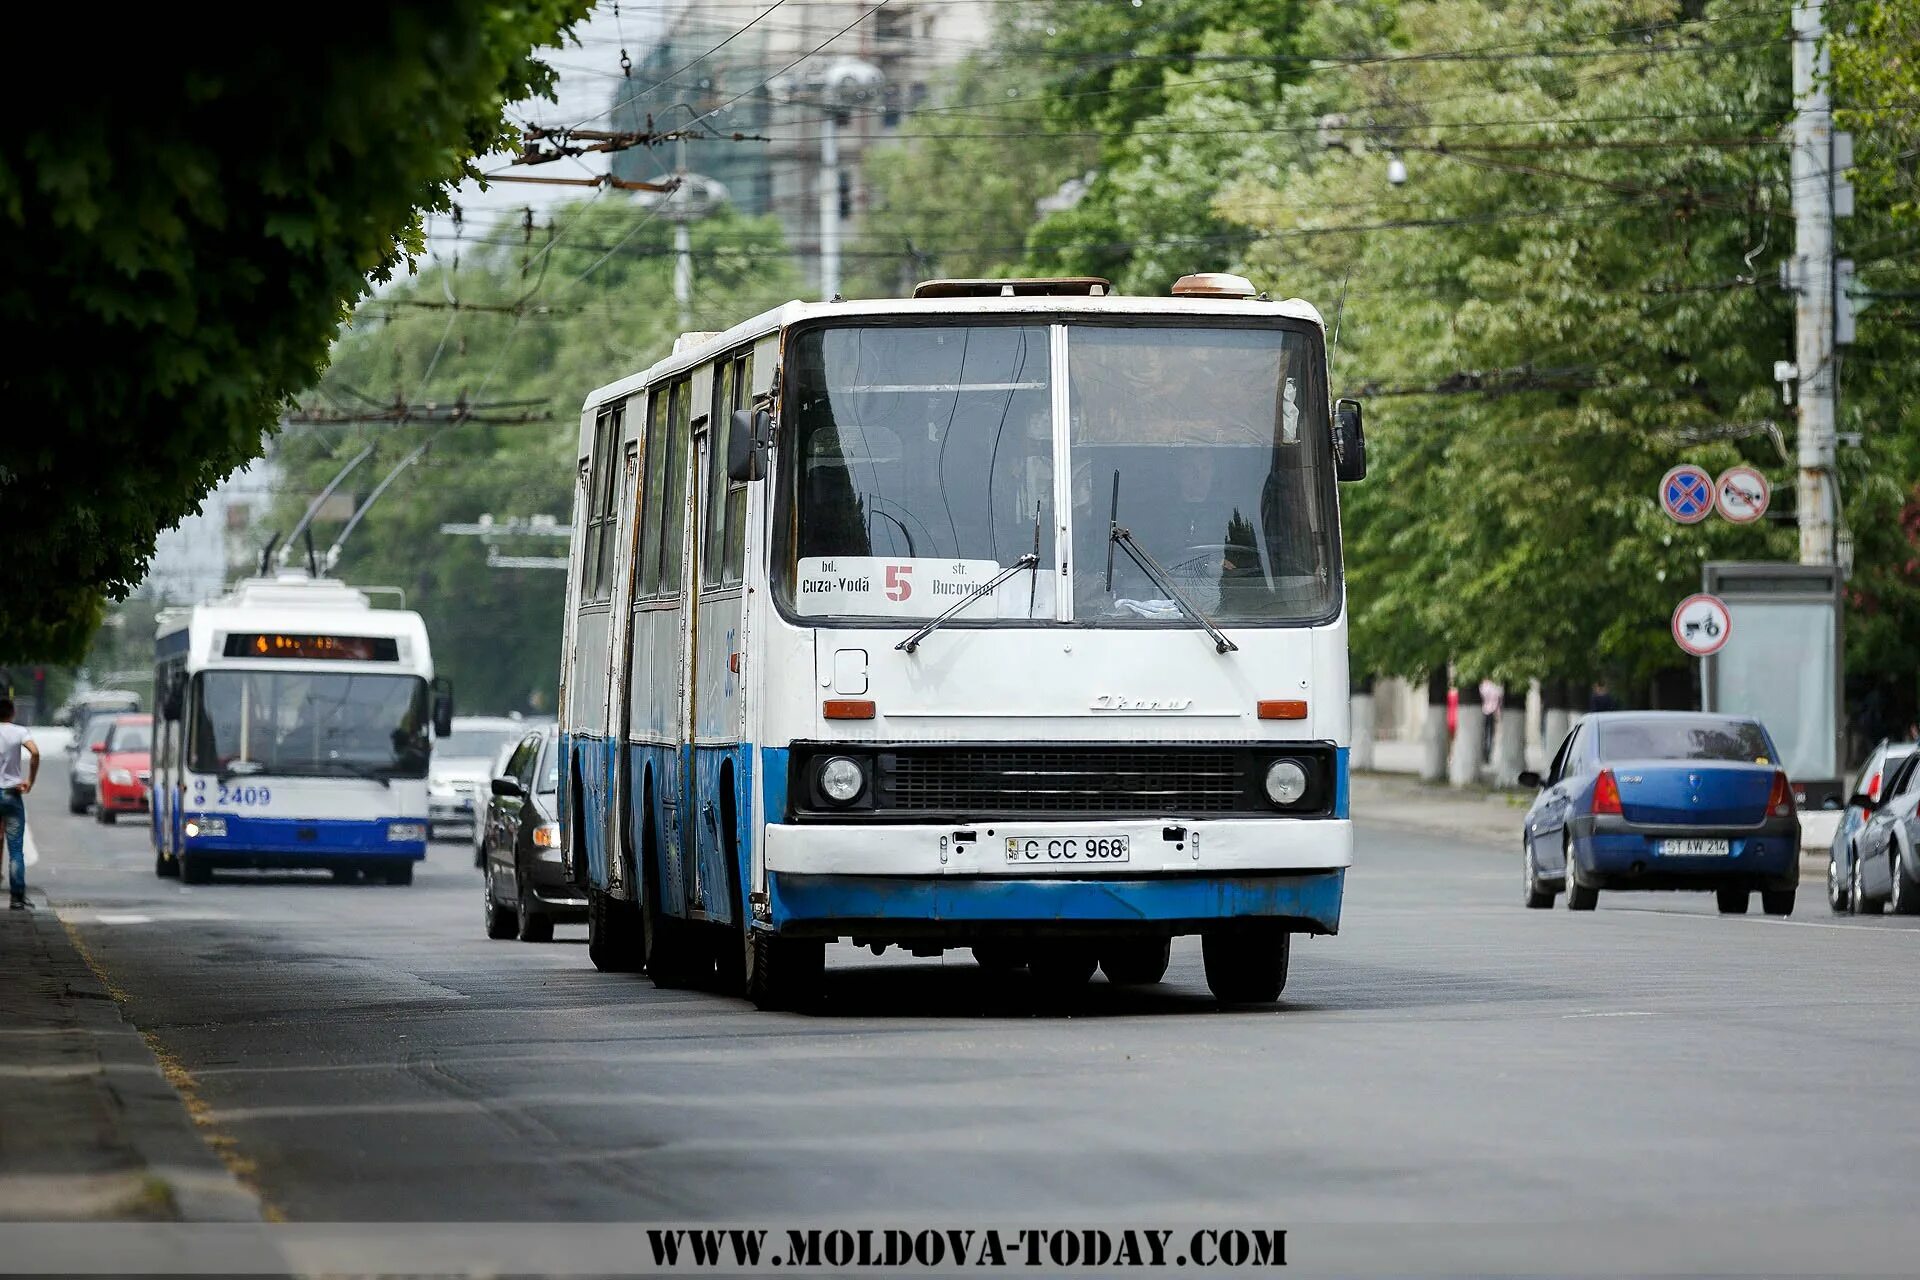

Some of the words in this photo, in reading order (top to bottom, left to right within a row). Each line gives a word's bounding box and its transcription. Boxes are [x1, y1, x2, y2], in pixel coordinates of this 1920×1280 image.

[821, 560, 837, 572] bd.
[952, 563, 967, 575] str.
[802, 576, 870, 593] Cuza-Vodă
[886, 565, 913, 602] 5
[1089, 695, 1192, 712] Ikarus
[218, 785, 270, 805] 2409
[1025, 840, 1039, 859] C
[1048, 839, 1077, 859] CC
[1085, 838, 1122, 859] 968
